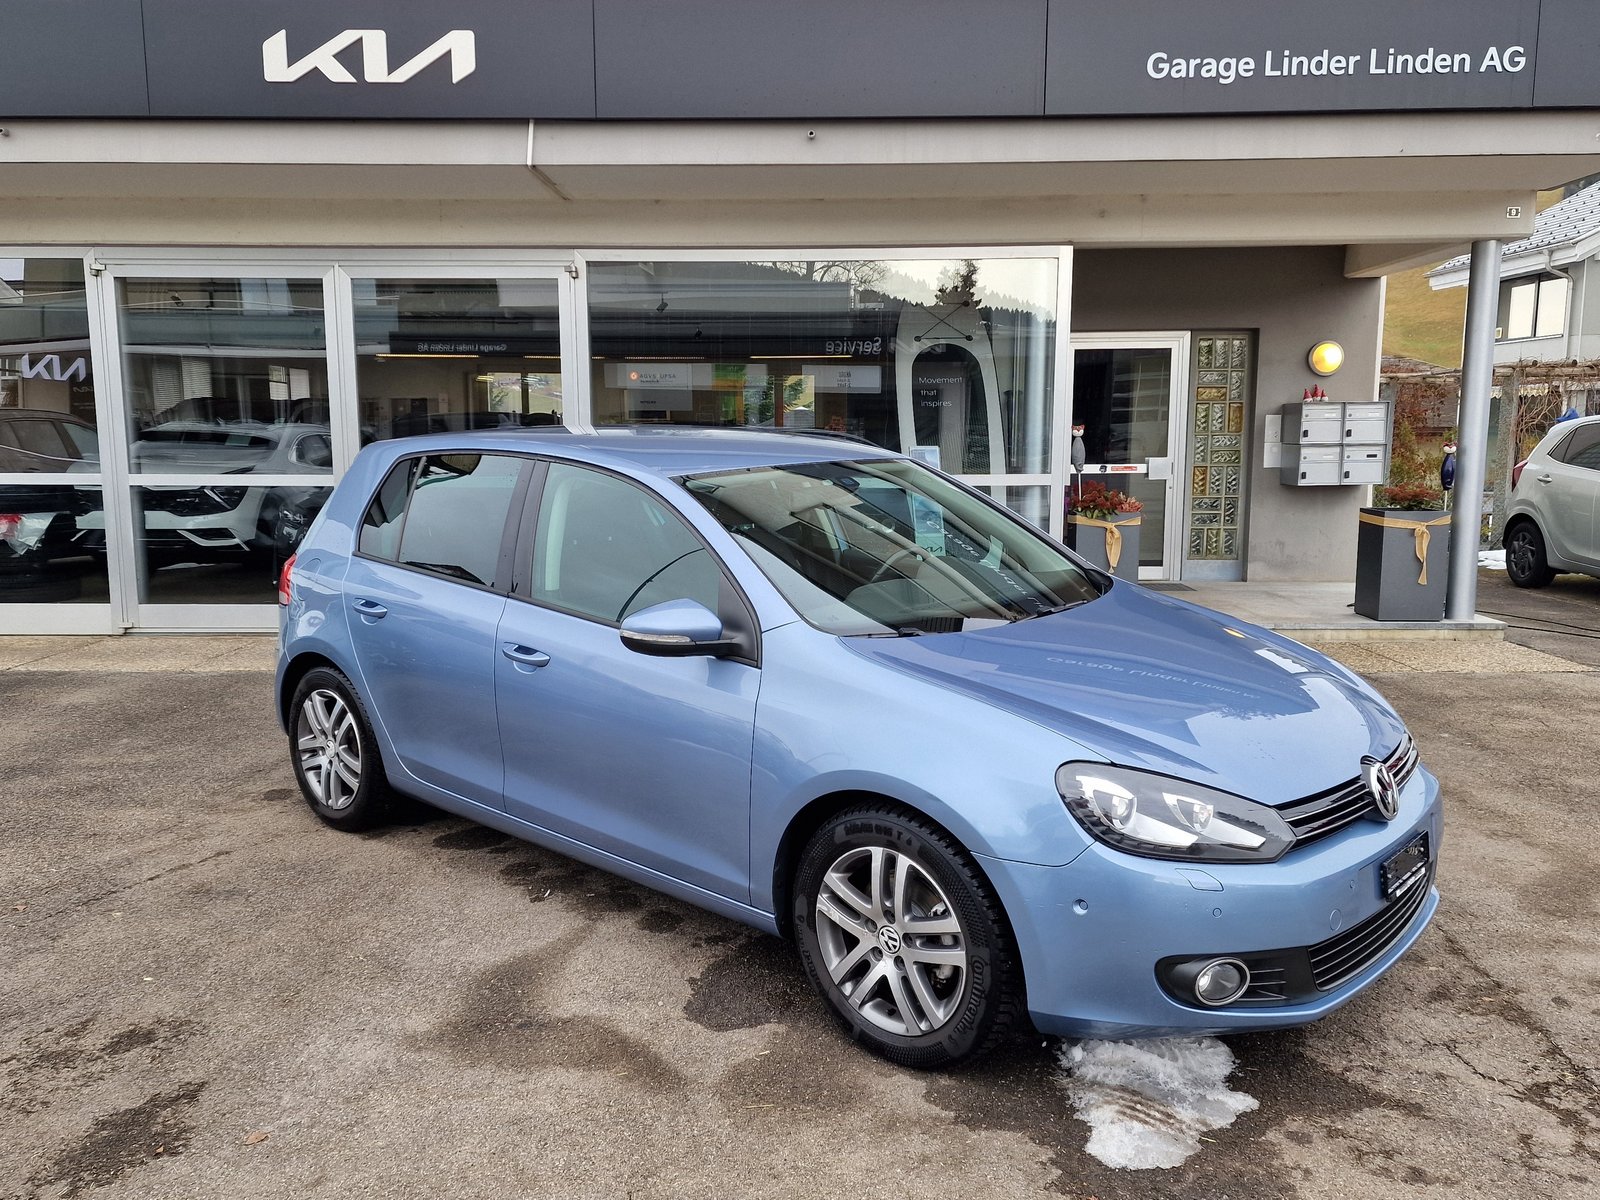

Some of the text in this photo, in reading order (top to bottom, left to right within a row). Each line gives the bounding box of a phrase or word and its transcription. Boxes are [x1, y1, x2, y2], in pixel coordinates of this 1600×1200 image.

[262, 29, 476, 84] KIA
[1146, 46, 1527, 84] Garage Linder Linden AG
